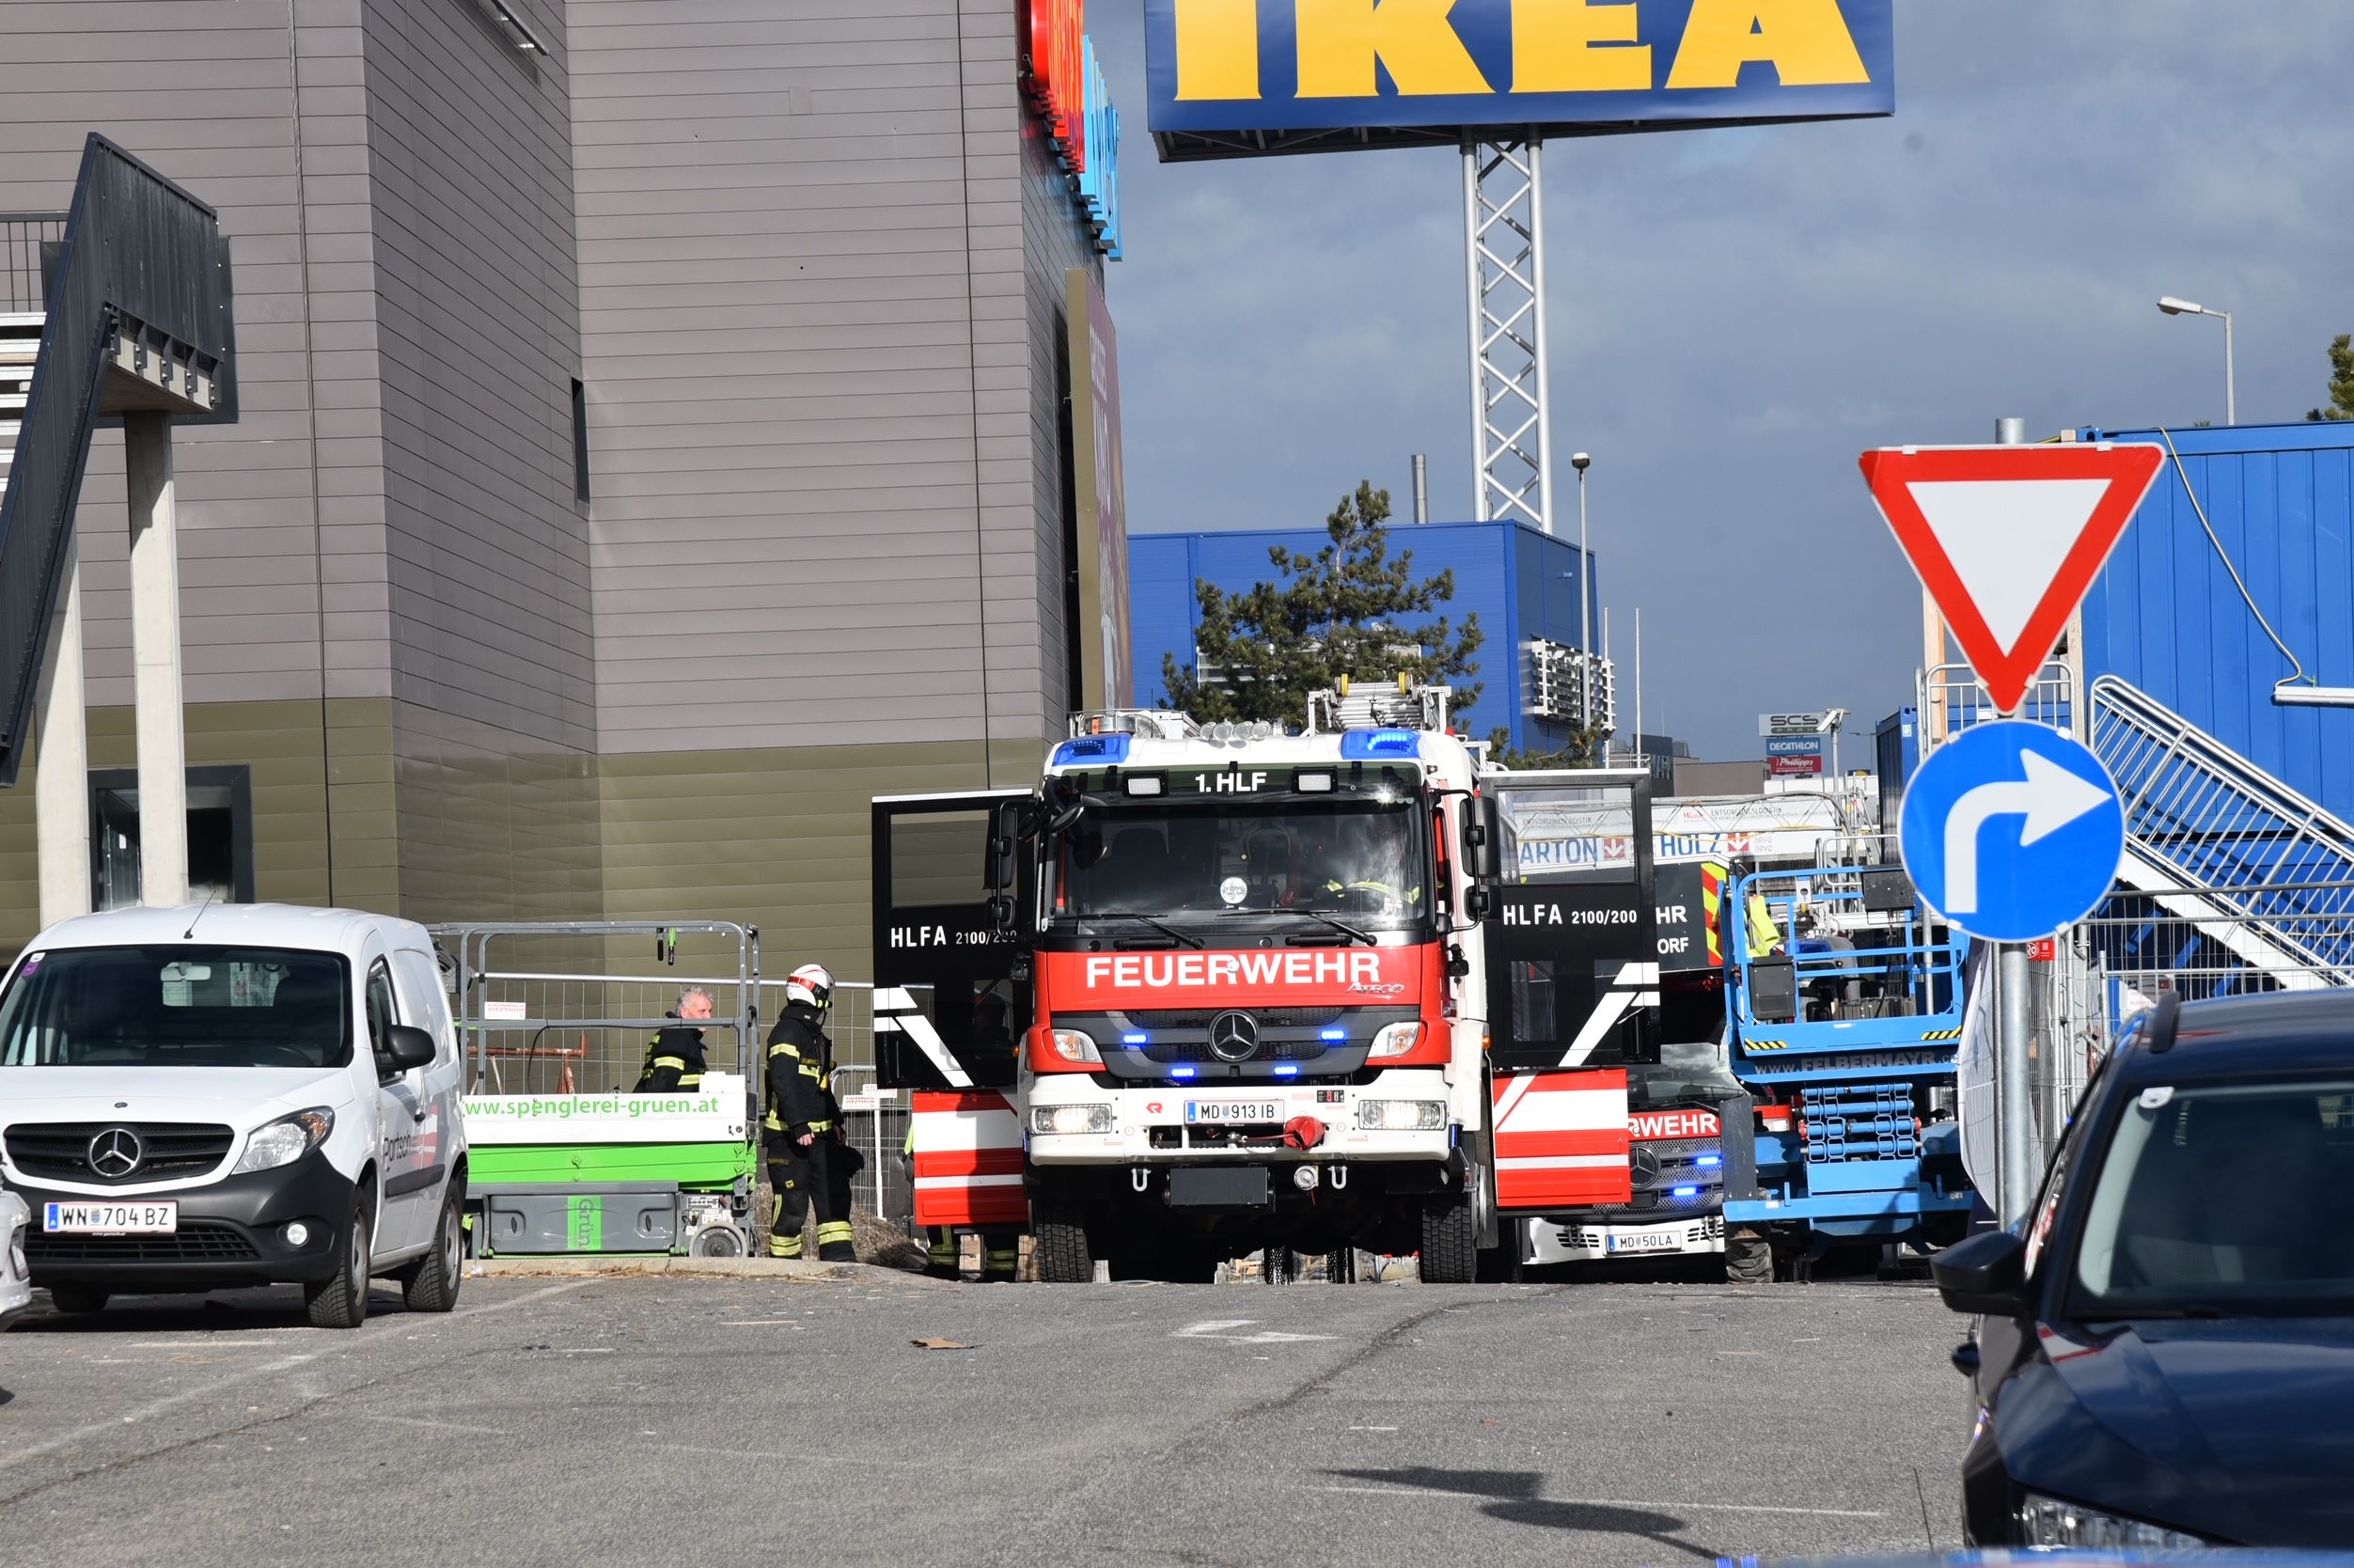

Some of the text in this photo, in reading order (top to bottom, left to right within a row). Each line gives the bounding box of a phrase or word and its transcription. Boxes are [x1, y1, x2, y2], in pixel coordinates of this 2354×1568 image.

[1173, 0, 1871, 101] IKEA
[1091, 393, 1111, 516] KINO
[1770, 714, 1819, 726] SCS
[1769, 741, 1818, 751] DECATHLON
[1780, 757, 1813, 767] Philipps
[1660, 833, 1722, 857] HOLZ
[1503, 903, 1638, 926] HLFA 2100/200
[1656, 905, 1687, 924] HR
[891, 925, 948, 949] HLFA
[1656, 937, 1689, 954] ORF
[1087, 951, 1381, 988] FEUERWEHR
[1201, 1105, 1220, 1119] MD
[1231, 1105, 1256, 1119] 913
[1262, 1105, 1275, 1119] IB
[62, 1207, 87, 1226] WN
[103, 1207, 138, 1226] 704
[145, 1207, 168, 1226] BZ
[1620, 1237, 1635, 1248] MD
[1642, 1235, 1656, 1247] 50
[1658, 1234, 1672, 1246] LA
